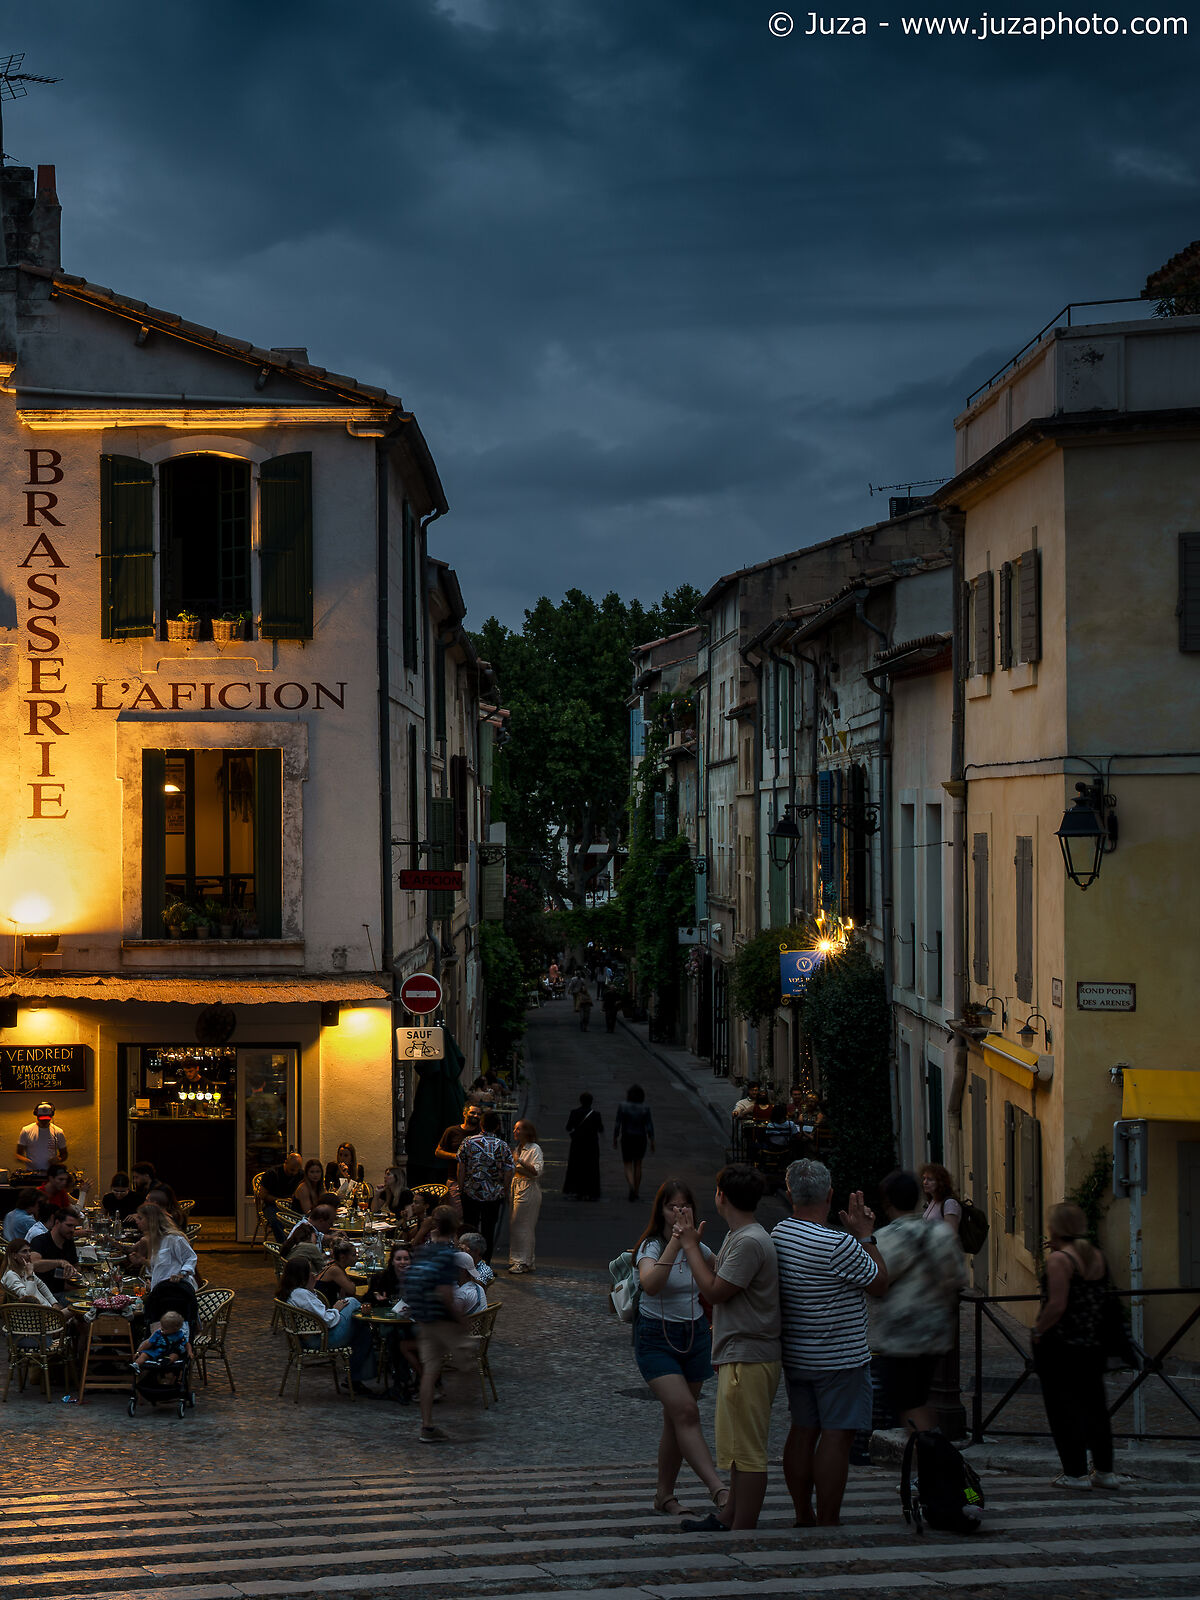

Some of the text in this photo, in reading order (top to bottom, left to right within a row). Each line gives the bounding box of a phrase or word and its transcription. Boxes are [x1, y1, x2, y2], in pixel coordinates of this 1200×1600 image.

[17, 448, 70, 820] BRASSERIE
[91, 682, 348, 711] L'AFICION
[406, 1030, 433, 1040] SAUF
